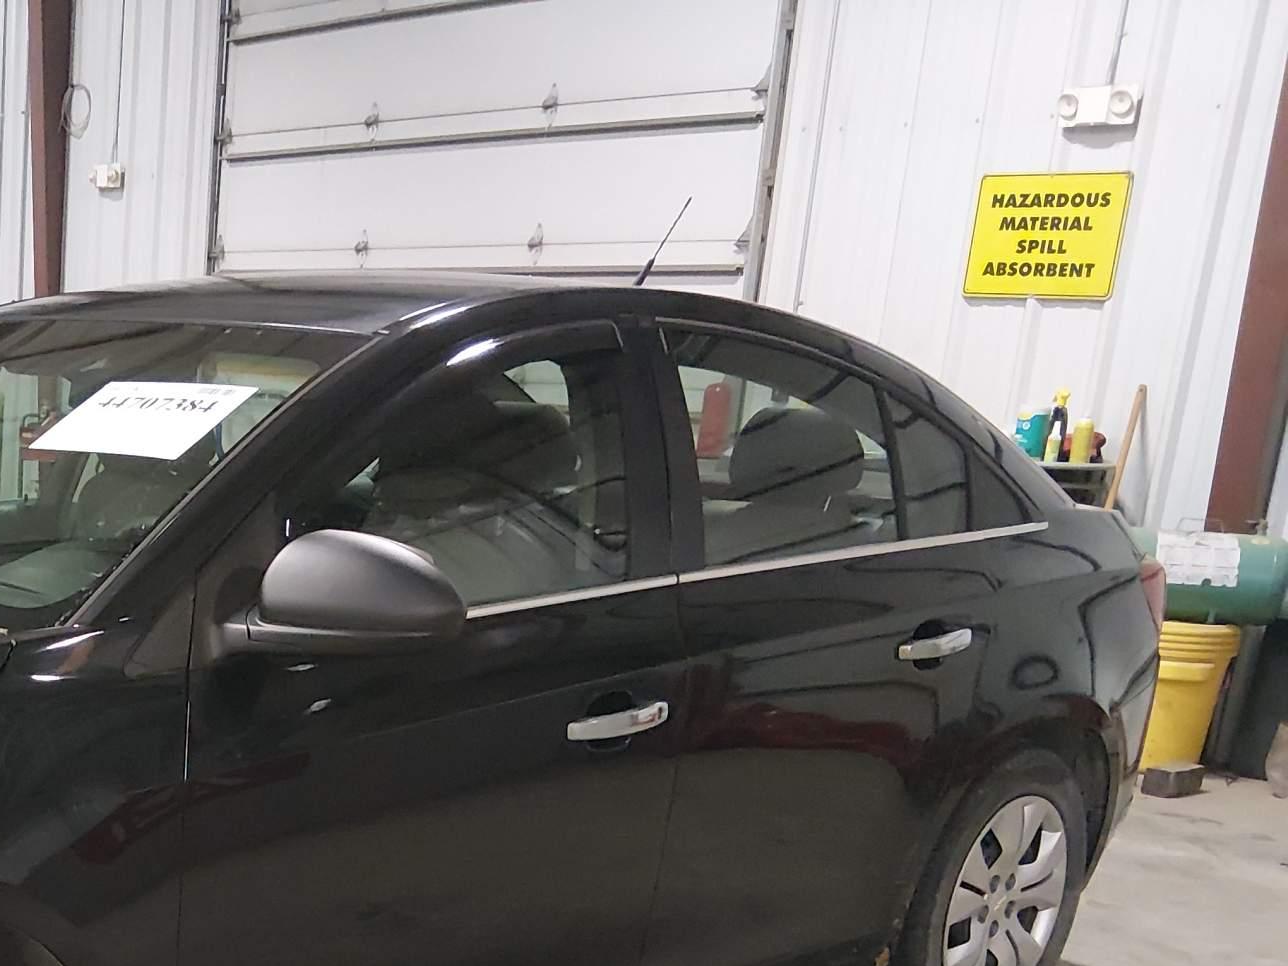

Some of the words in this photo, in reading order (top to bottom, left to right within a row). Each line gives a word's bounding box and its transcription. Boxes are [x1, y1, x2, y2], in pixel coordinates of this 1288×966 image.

[991, 192, 1112, 209] HAZARDOUS
[999, 216, 1093, 232] MATERIAL
[1015, 239, 1067, 255] SPILL
[982, 262, 1095, 279] ABSORBENT
[98, 396, 219, 413] 44707384
